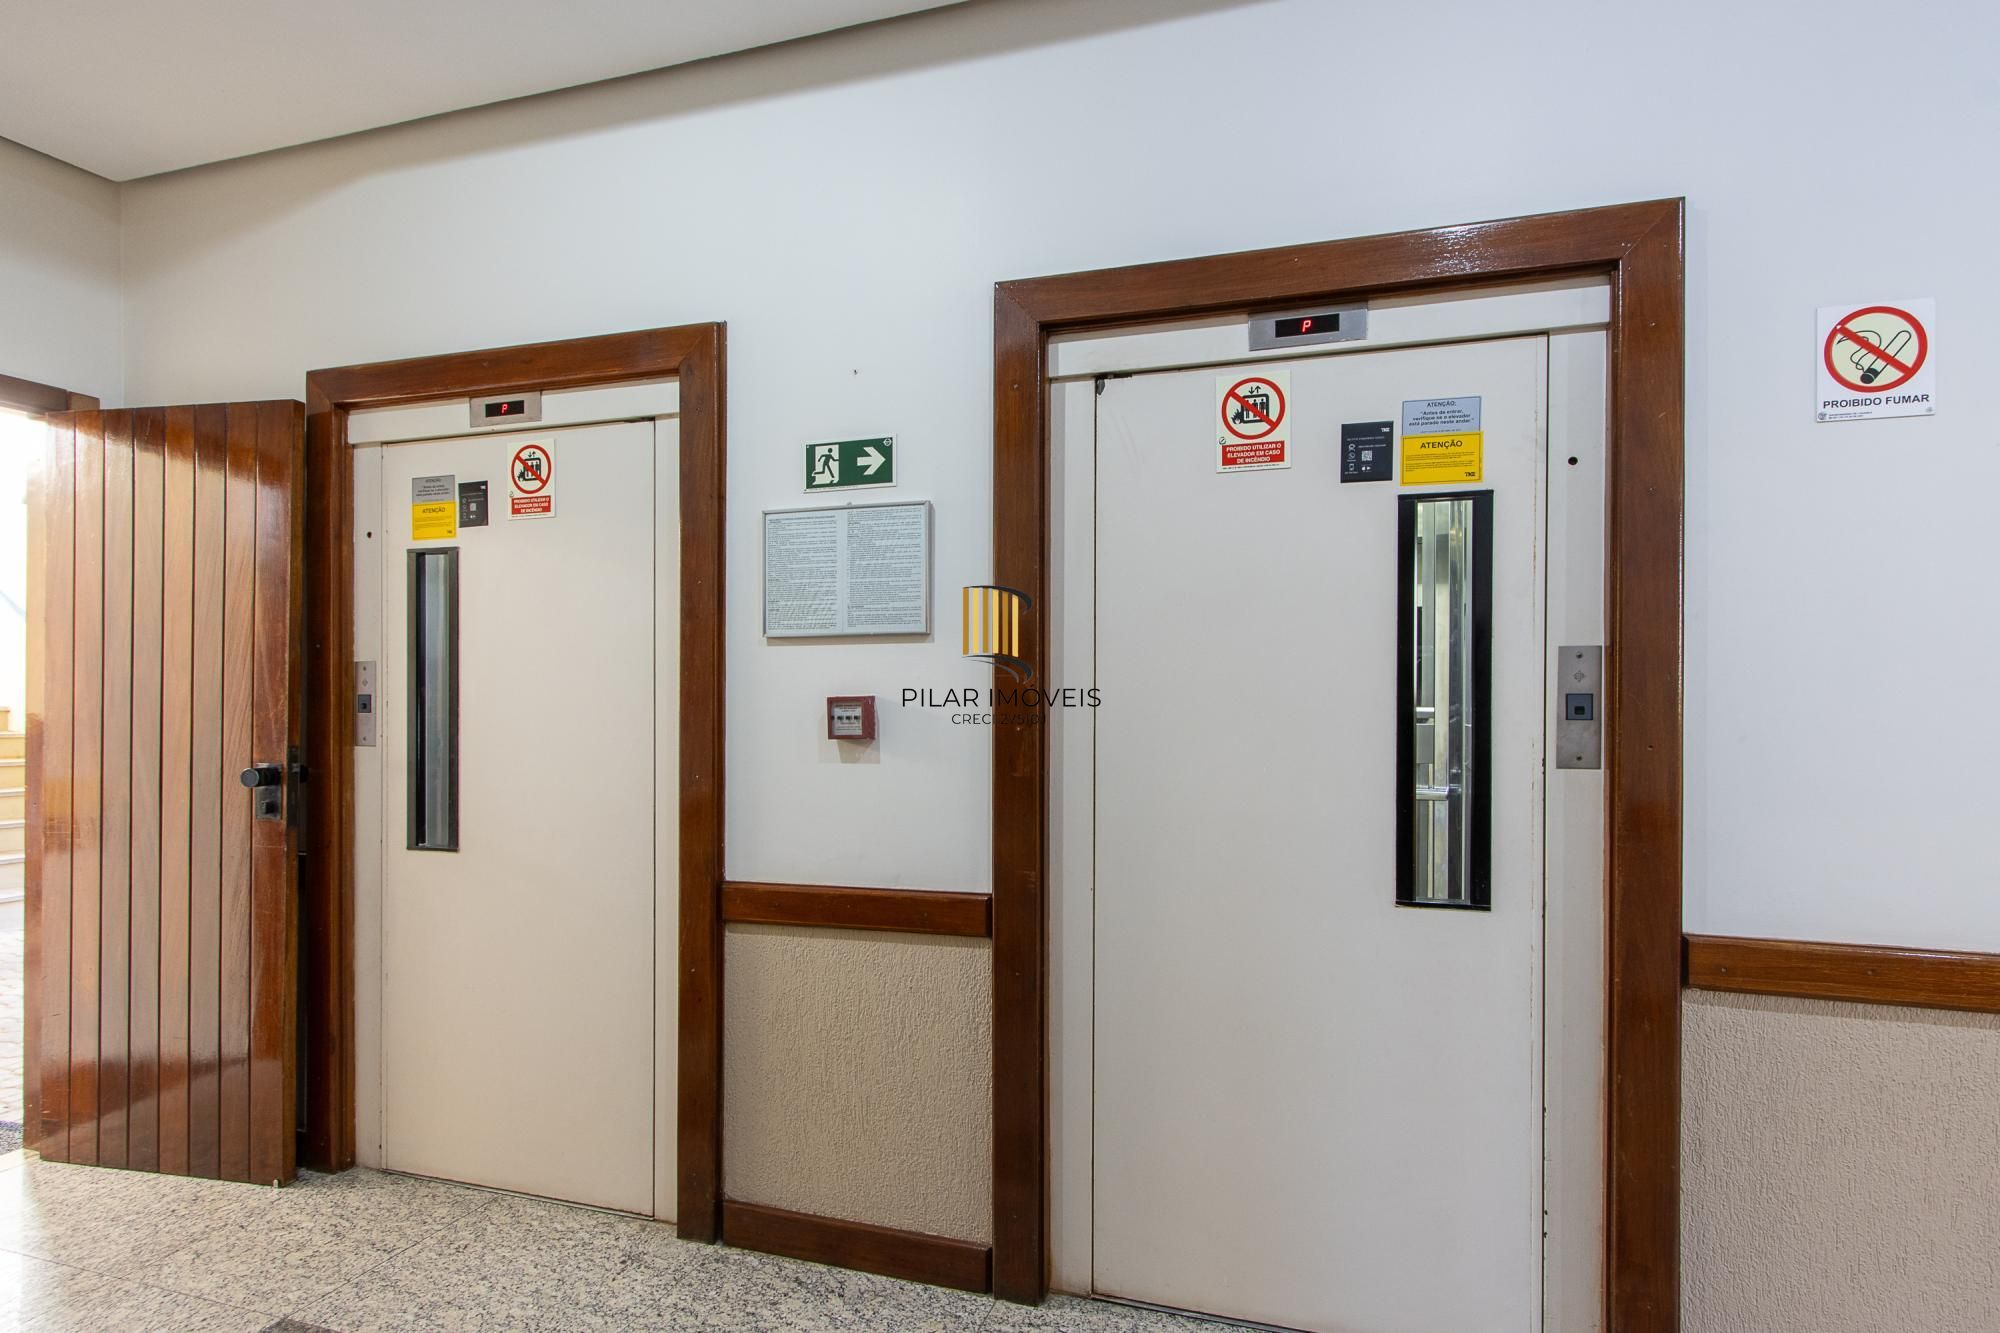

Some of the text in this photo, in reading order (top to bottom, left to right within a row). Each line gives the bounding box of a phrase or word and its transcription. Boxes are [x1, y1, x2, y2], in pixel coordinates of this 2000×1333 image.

[1302, 320, 1312, 333] P
[1823, 394, 1930, 409] PROIBIDO FUMAR
[501, 403, 508, 414] P
[1420, 439, 1463, 449] ATENÇÃO
